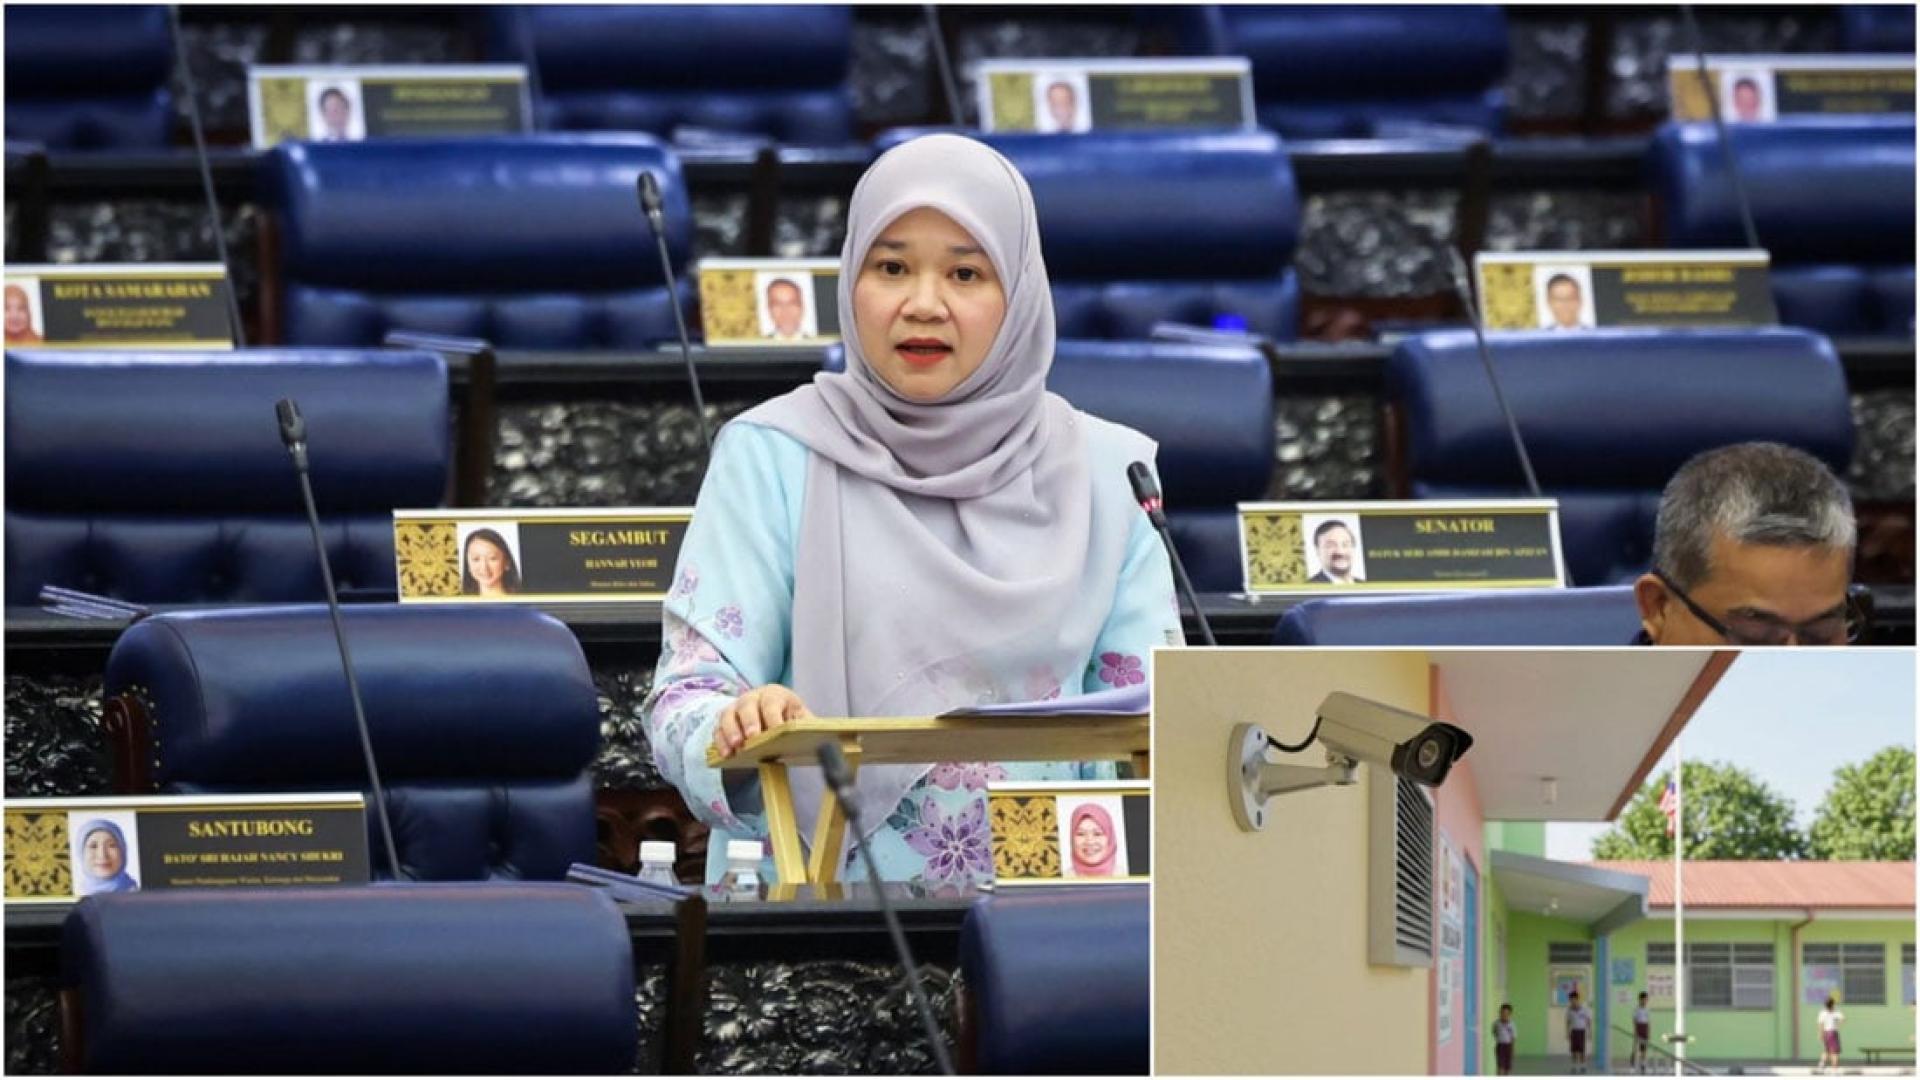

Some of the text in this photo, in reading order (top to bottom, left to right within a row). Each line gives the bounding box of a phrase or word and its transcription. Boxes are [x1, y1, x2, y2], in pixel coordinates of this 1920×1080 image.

[1414, 518, 1495, 534] SENATOR
[569, 529, 669, 546] SEGAMBUT
[188, 819, 313, 838] SANTUBONG
